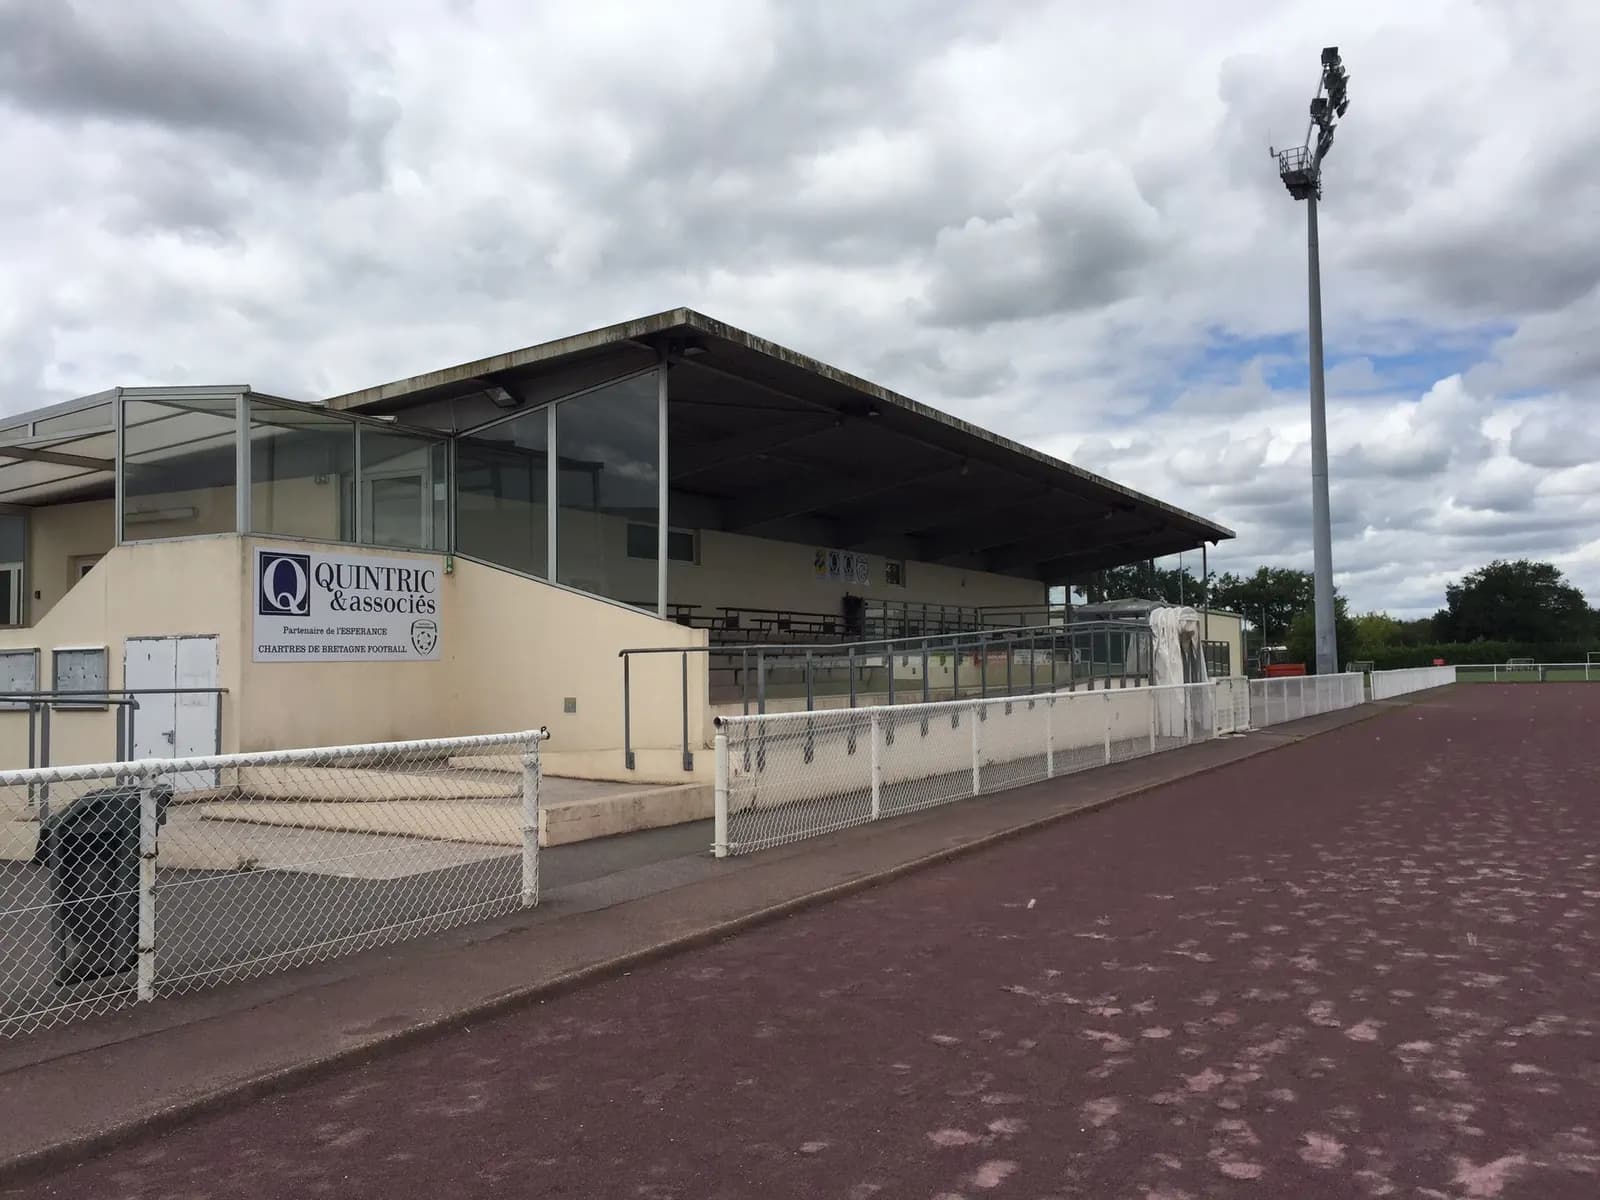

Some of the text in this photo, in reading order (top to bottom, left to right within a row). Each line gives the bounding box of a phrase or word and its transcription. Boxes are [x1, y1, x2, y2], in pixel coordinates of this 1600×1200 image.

[315, 562, 436, 594] QUINTRIC
[283, 626, 324, 635] Partenaire
[326, 627, 335, 635] de
[258, 645, 407, 653] CHARTRES DE BRETAGNE FOOTBALL
